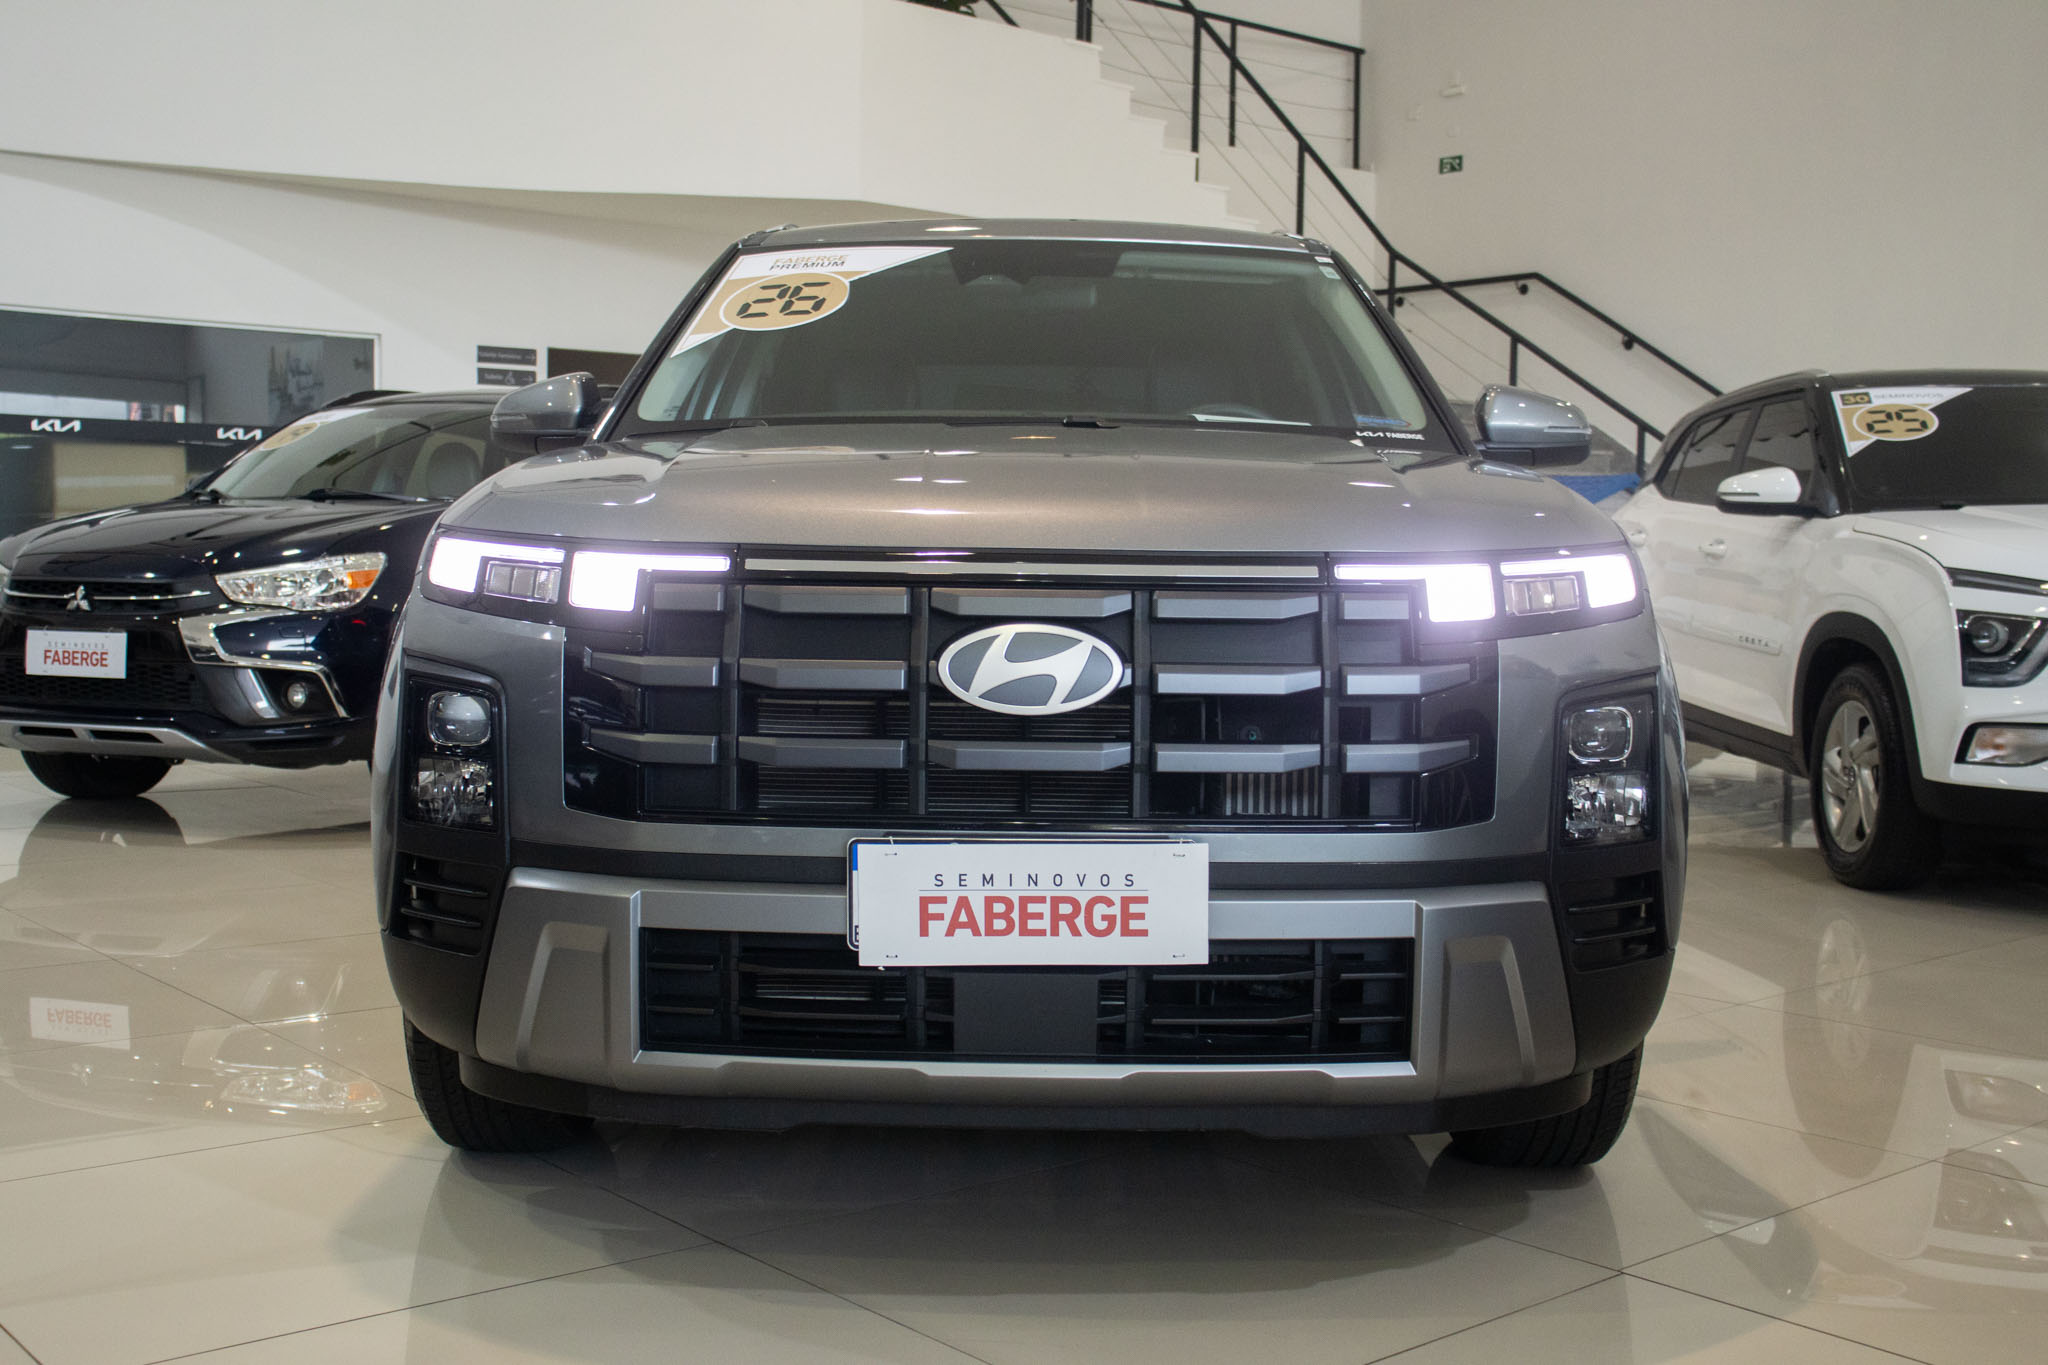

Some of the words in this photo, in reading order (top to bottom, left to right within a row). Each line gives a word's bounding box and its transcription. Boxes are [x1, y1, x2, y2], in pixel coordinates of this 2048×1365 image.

[769, 260, 845, 271] PREMIUM
[773, 254, 848, 265] FABERGE
[736, 281, 831, 318] 26
[1841, 393, 1870, 404] 30
[1865, 408, 1929, 434] 25
[43, 649, 109, 667] FABERGE
[933, 873, 1135, 888] SEMINOVOS
[919, 895, 1149, 938] FABERGE
